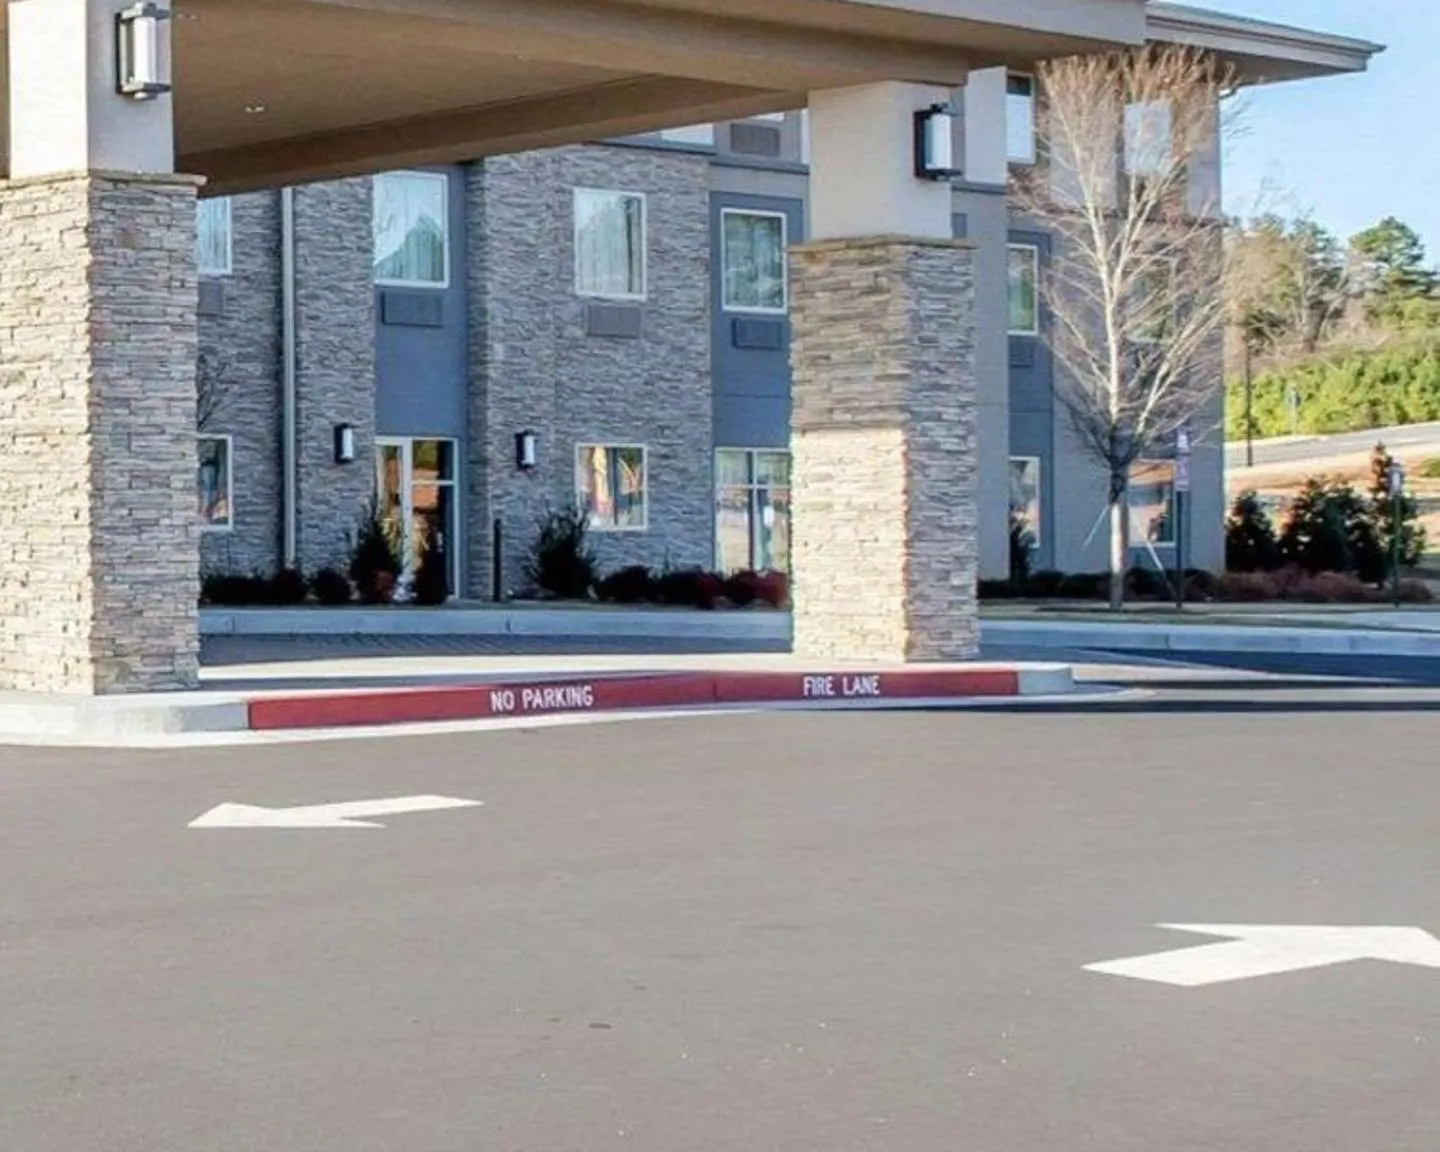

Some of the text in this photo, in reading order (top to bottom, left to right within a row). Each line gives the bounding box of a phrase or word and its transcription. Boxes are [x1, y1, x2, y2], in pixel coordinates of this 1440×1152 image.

[803, 675, 881, 696] FIRE LANE
[490, 685, 593, 711] NO PARKING
